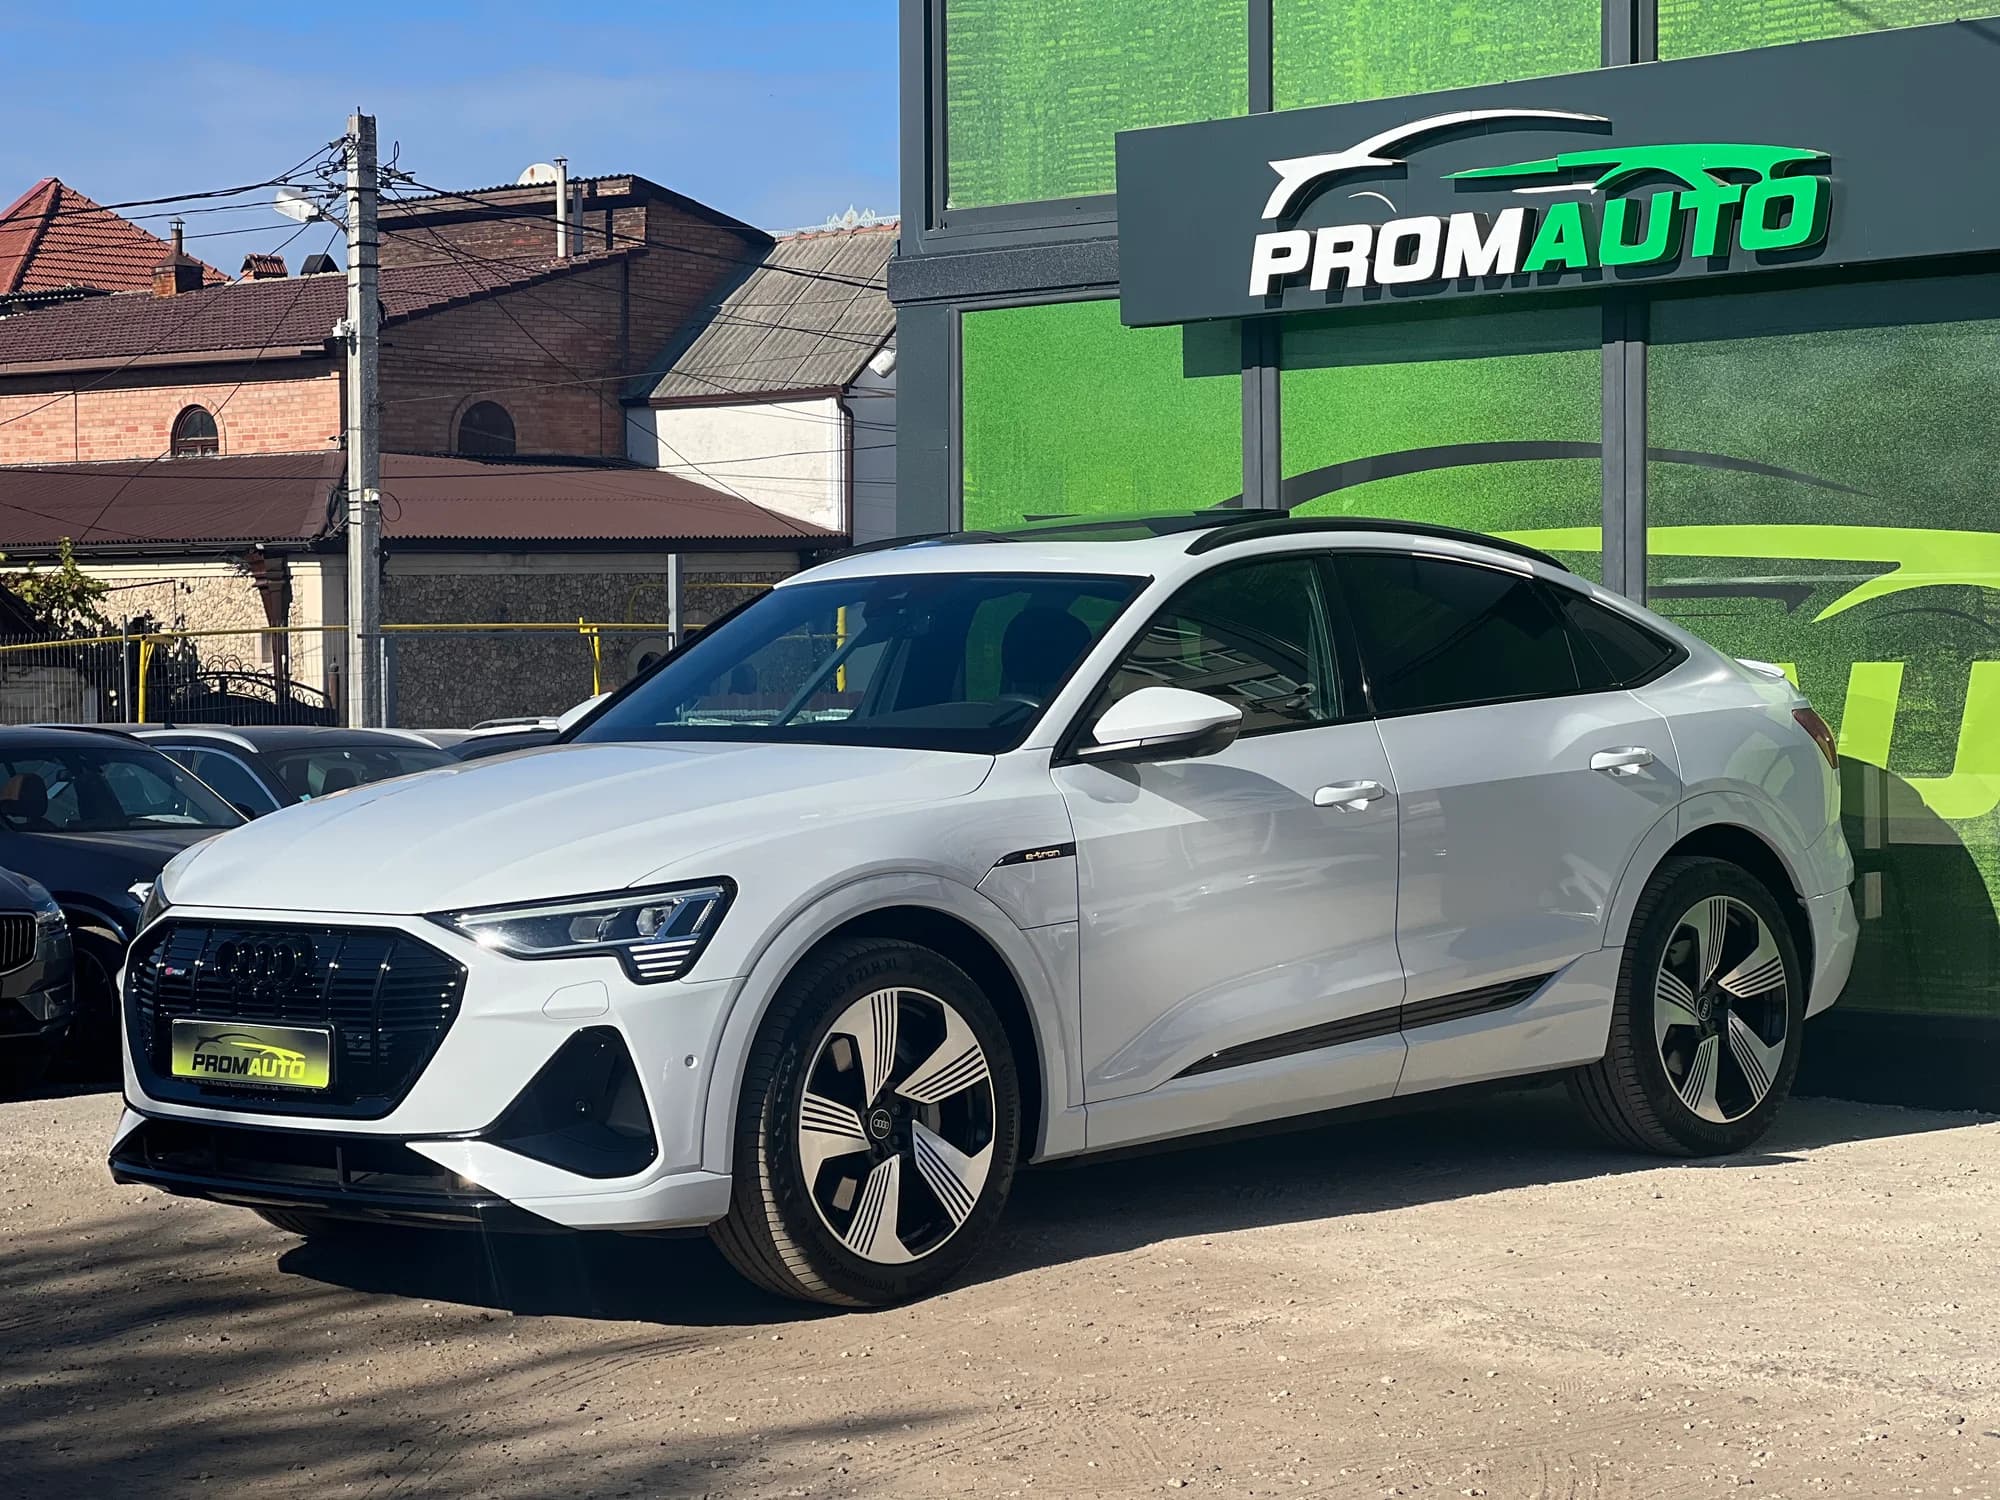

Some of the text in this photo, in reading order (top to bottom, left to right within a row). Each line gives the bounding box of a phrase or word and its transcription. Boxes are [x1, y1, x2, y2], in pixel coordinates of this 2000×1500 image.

[1248, 176, 1820, 297] PROMAUTO
[1773, 662, 2000, 820] U
[1025, 848, 1061, 861] e-tron
[191, 1053, 306, 1079] PROMAUTO
